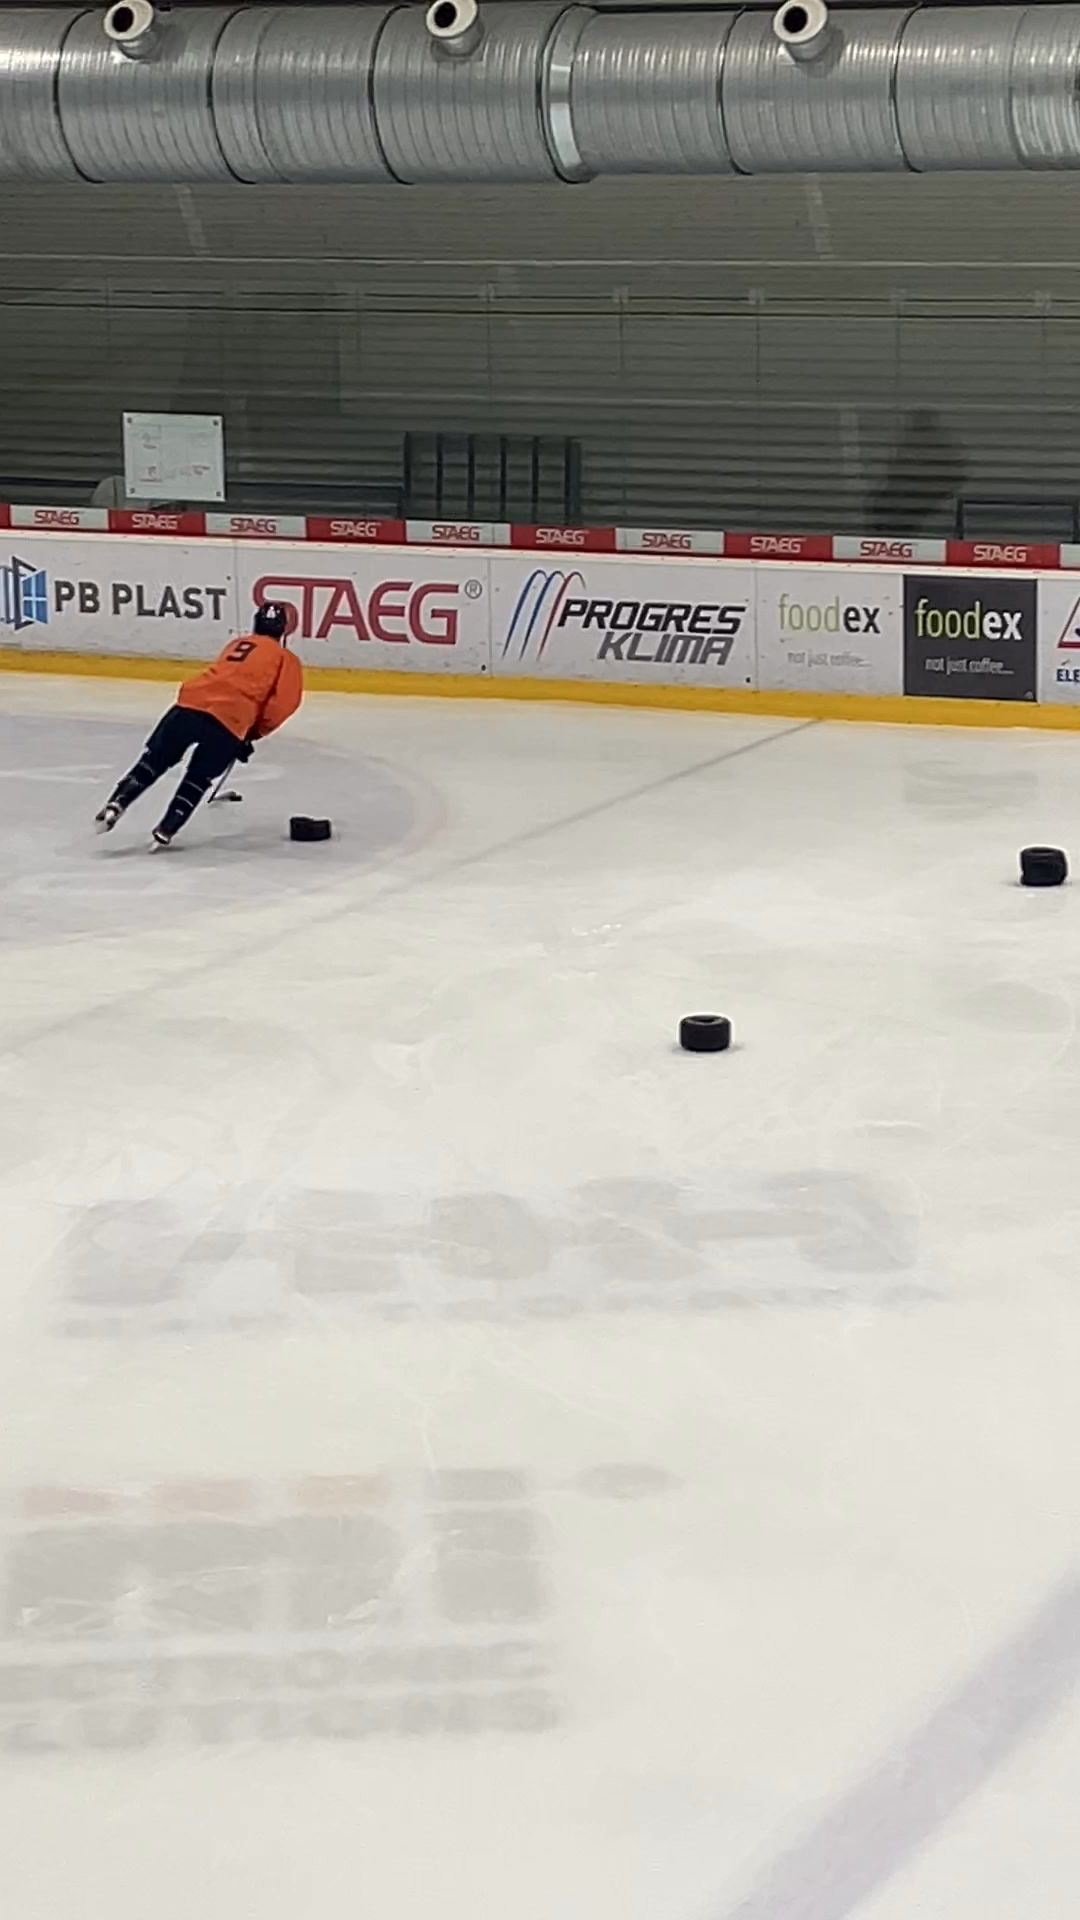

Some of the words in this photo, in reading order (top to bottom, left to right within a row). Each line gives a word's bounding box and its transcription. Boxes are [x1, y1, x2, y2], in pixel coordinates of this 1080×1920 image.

[34, 510, 80, 525] STAEG
[131, 514, 179, 530] STAEG
[230, 517, 277, 533] STAEG
[330, 521, 377, 537] STAEG
[432, 525, 480, 541] STAEG
[536, 529, 584, 544] STAEG
[642, 533, 692, 549] STAEG
[750, 537, 800, 553] STAEG
[860, 541, 913, 557] STAEG
[973, 545, 1026, 562] STAEG
[54, 580, 100, 614] PB
[112, 583, 227, 620] PLAST
[557, 599, 746, 634] PROGRES
[778, 594, 881, 634] foodex
[914, 599, 1022, 641] foodex
[227, 641, 257, 662] 9
[597, 631, 734, 666] KLIMA
[925, 658, 944, 671] not
[946, 657, 967, 675] just
